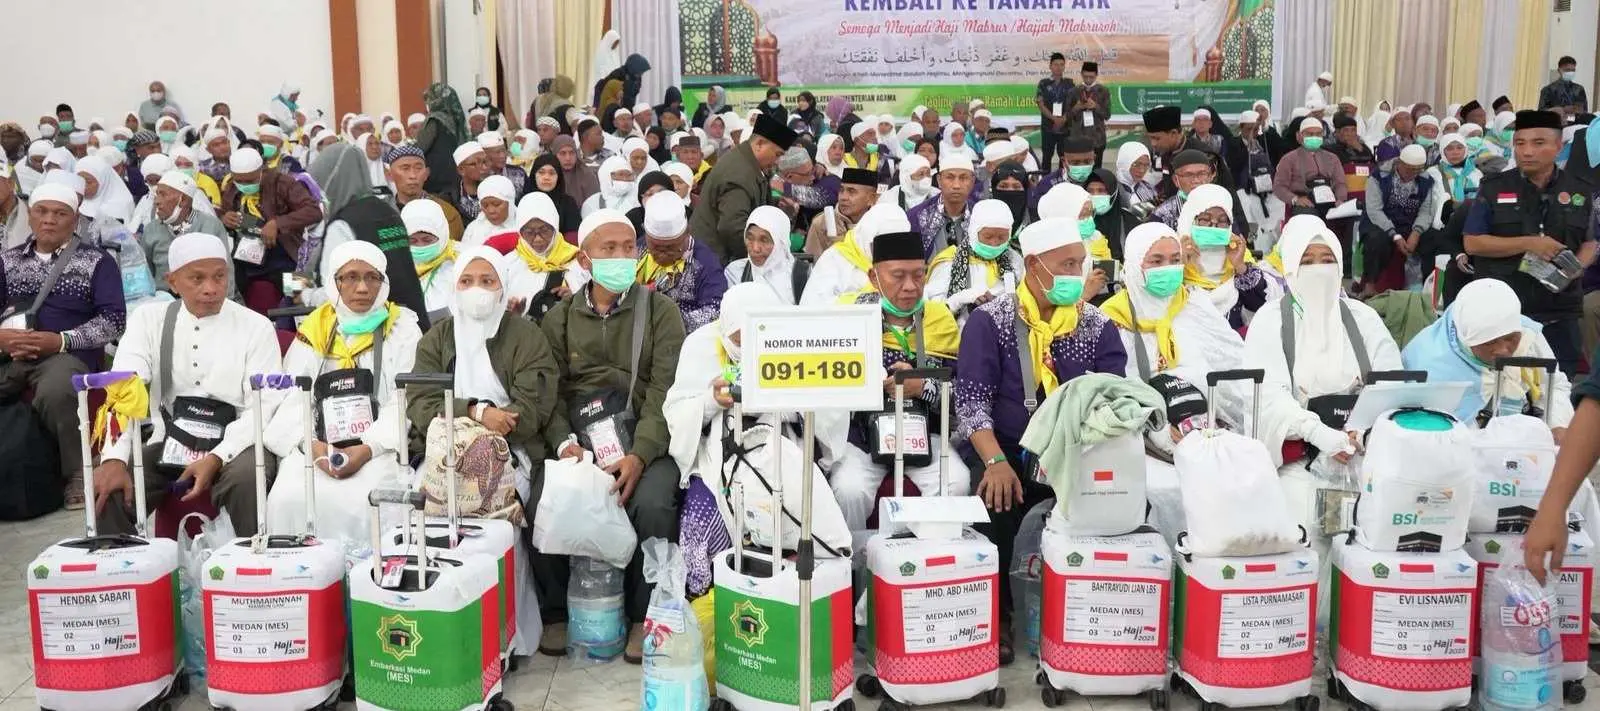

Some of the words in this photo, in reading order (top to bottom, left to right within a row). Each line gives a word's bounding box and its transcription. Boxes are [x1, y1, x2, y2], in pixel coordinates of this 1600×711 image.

[845, 0, 942, 11] KEMBALI
[952, 0, 977, 10] KE
[988, 0, 1062, 10] TANAH
[1071, 0, 1110, 9] AIR
[839, 21, 880, 37] Semoga
[885, 19, 932, 37] Menjadi
[935, 19, 958, 36] Haji
[963, 19, 1008, 33] Mabrur
[764, 339, 803, 349] NOMOR
[805, 338, 859, 348] MANIFEST
[761, 360, 863, 381] 091-180
[597, 443, 618, 460] 094
[1490, 481, 1517, 497] BSI
[1392, 512, 1418, 526] BSI
[925, 589, 945, 599] MHD.
[946, 586, 962, 595] ABD
[963, 582, 988, 593] HAMID
[1092, 582, 1130, 593] BAHTRAYUDI
[1131, 584, 1145, 594] LIAN
[1146, 585, 1157, 594] LBS
[60, 595, 97, 606] HENDRA
[98, 591, 131, 603] SABARI
[1242, 596, 1259, 605] LISTA
[1260, 592, 1305, 605] PURNAMASARI
[1399, 595, 1414, 604] EVI
[1417, 594, 1468, 604] LISNAWATI
[925, 612, 954, 621] MEDAN
[955, 608, 977, 618] (MES)
[1090, 606, 1120, 614] MEDAN
[1121, 607, 1144, 617] (MES)
[62, 620, 94, 628] MEDAN
[96, 617, 120, 628] (MES)
[232, 623, 263, 631] MEDAN
[265, 621, 289, 631] (MES)
[1241, 619, 1270, 627] MEDAN
[1272, 617, 1294, 628] (MES)
[1398, 620, 1430, 628] MEDAN
[1431, 620, 1455, 629] (MES)
[959, 626, 976, 642] Haji
[1123, 626, 1143, 640] Haji
[1398, 631, 1408, 639] 02
[104, 634, 123, 650] Haji
[274, 640, 292, 655] Haji
[1278, 635, 1295, 648] Haji
[1422, 644, 1432, 652] 10
[1433, 639, 1453, 654] Haji
[724, 643, 755, 660] Embarkasi
[755, 653, 777, 665] Medan
[370, 659, 406, 672] Embarkasi
[407, 665, 431, 675] Medan
[738, 657, 762, 671] (MES)
[386, 671, 413, 685] (MES)
